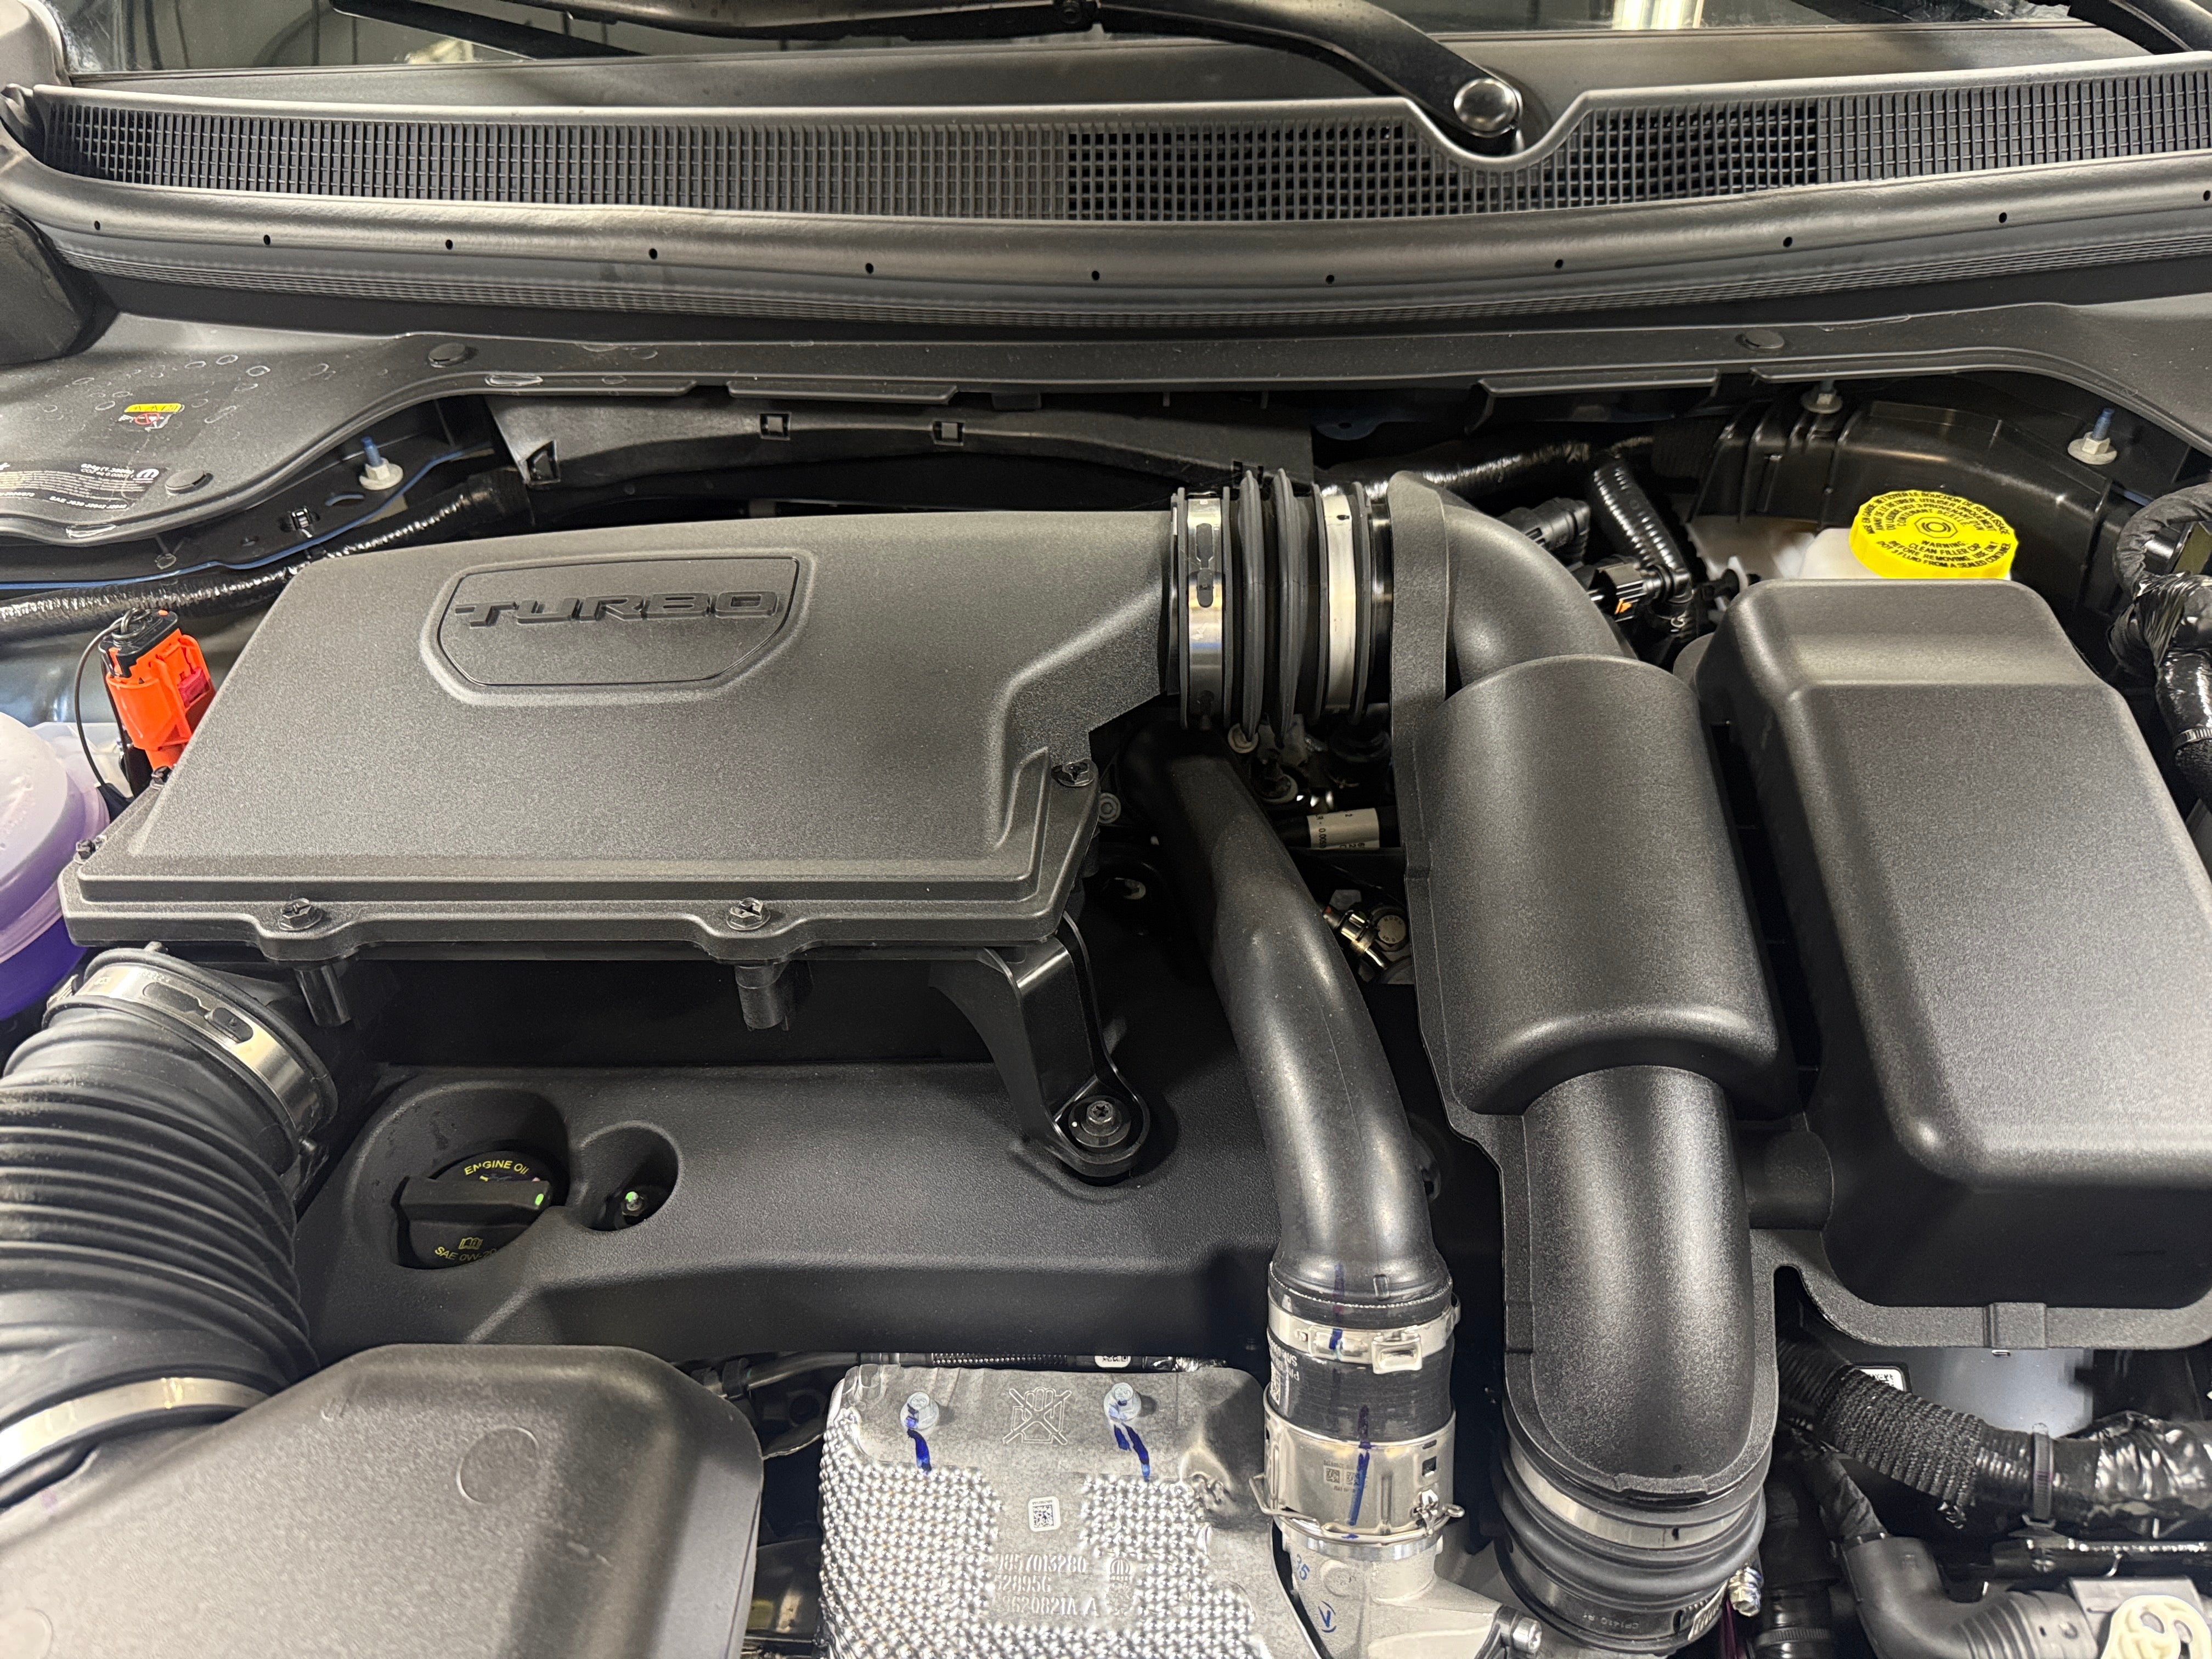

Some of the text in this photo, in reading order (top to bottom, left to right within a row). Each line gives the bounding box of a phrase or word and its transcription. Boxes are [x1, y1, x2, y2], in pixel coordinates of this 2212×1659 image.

[1888, 540, 1921, 557] BEFORE
[1909, 543, 1937, 554] CLEAN
[454, 590, 780, 628] TURBO
[464, 1160, 513, 1176] ENGINE
[435, 1246, 459, 1260] SAE
